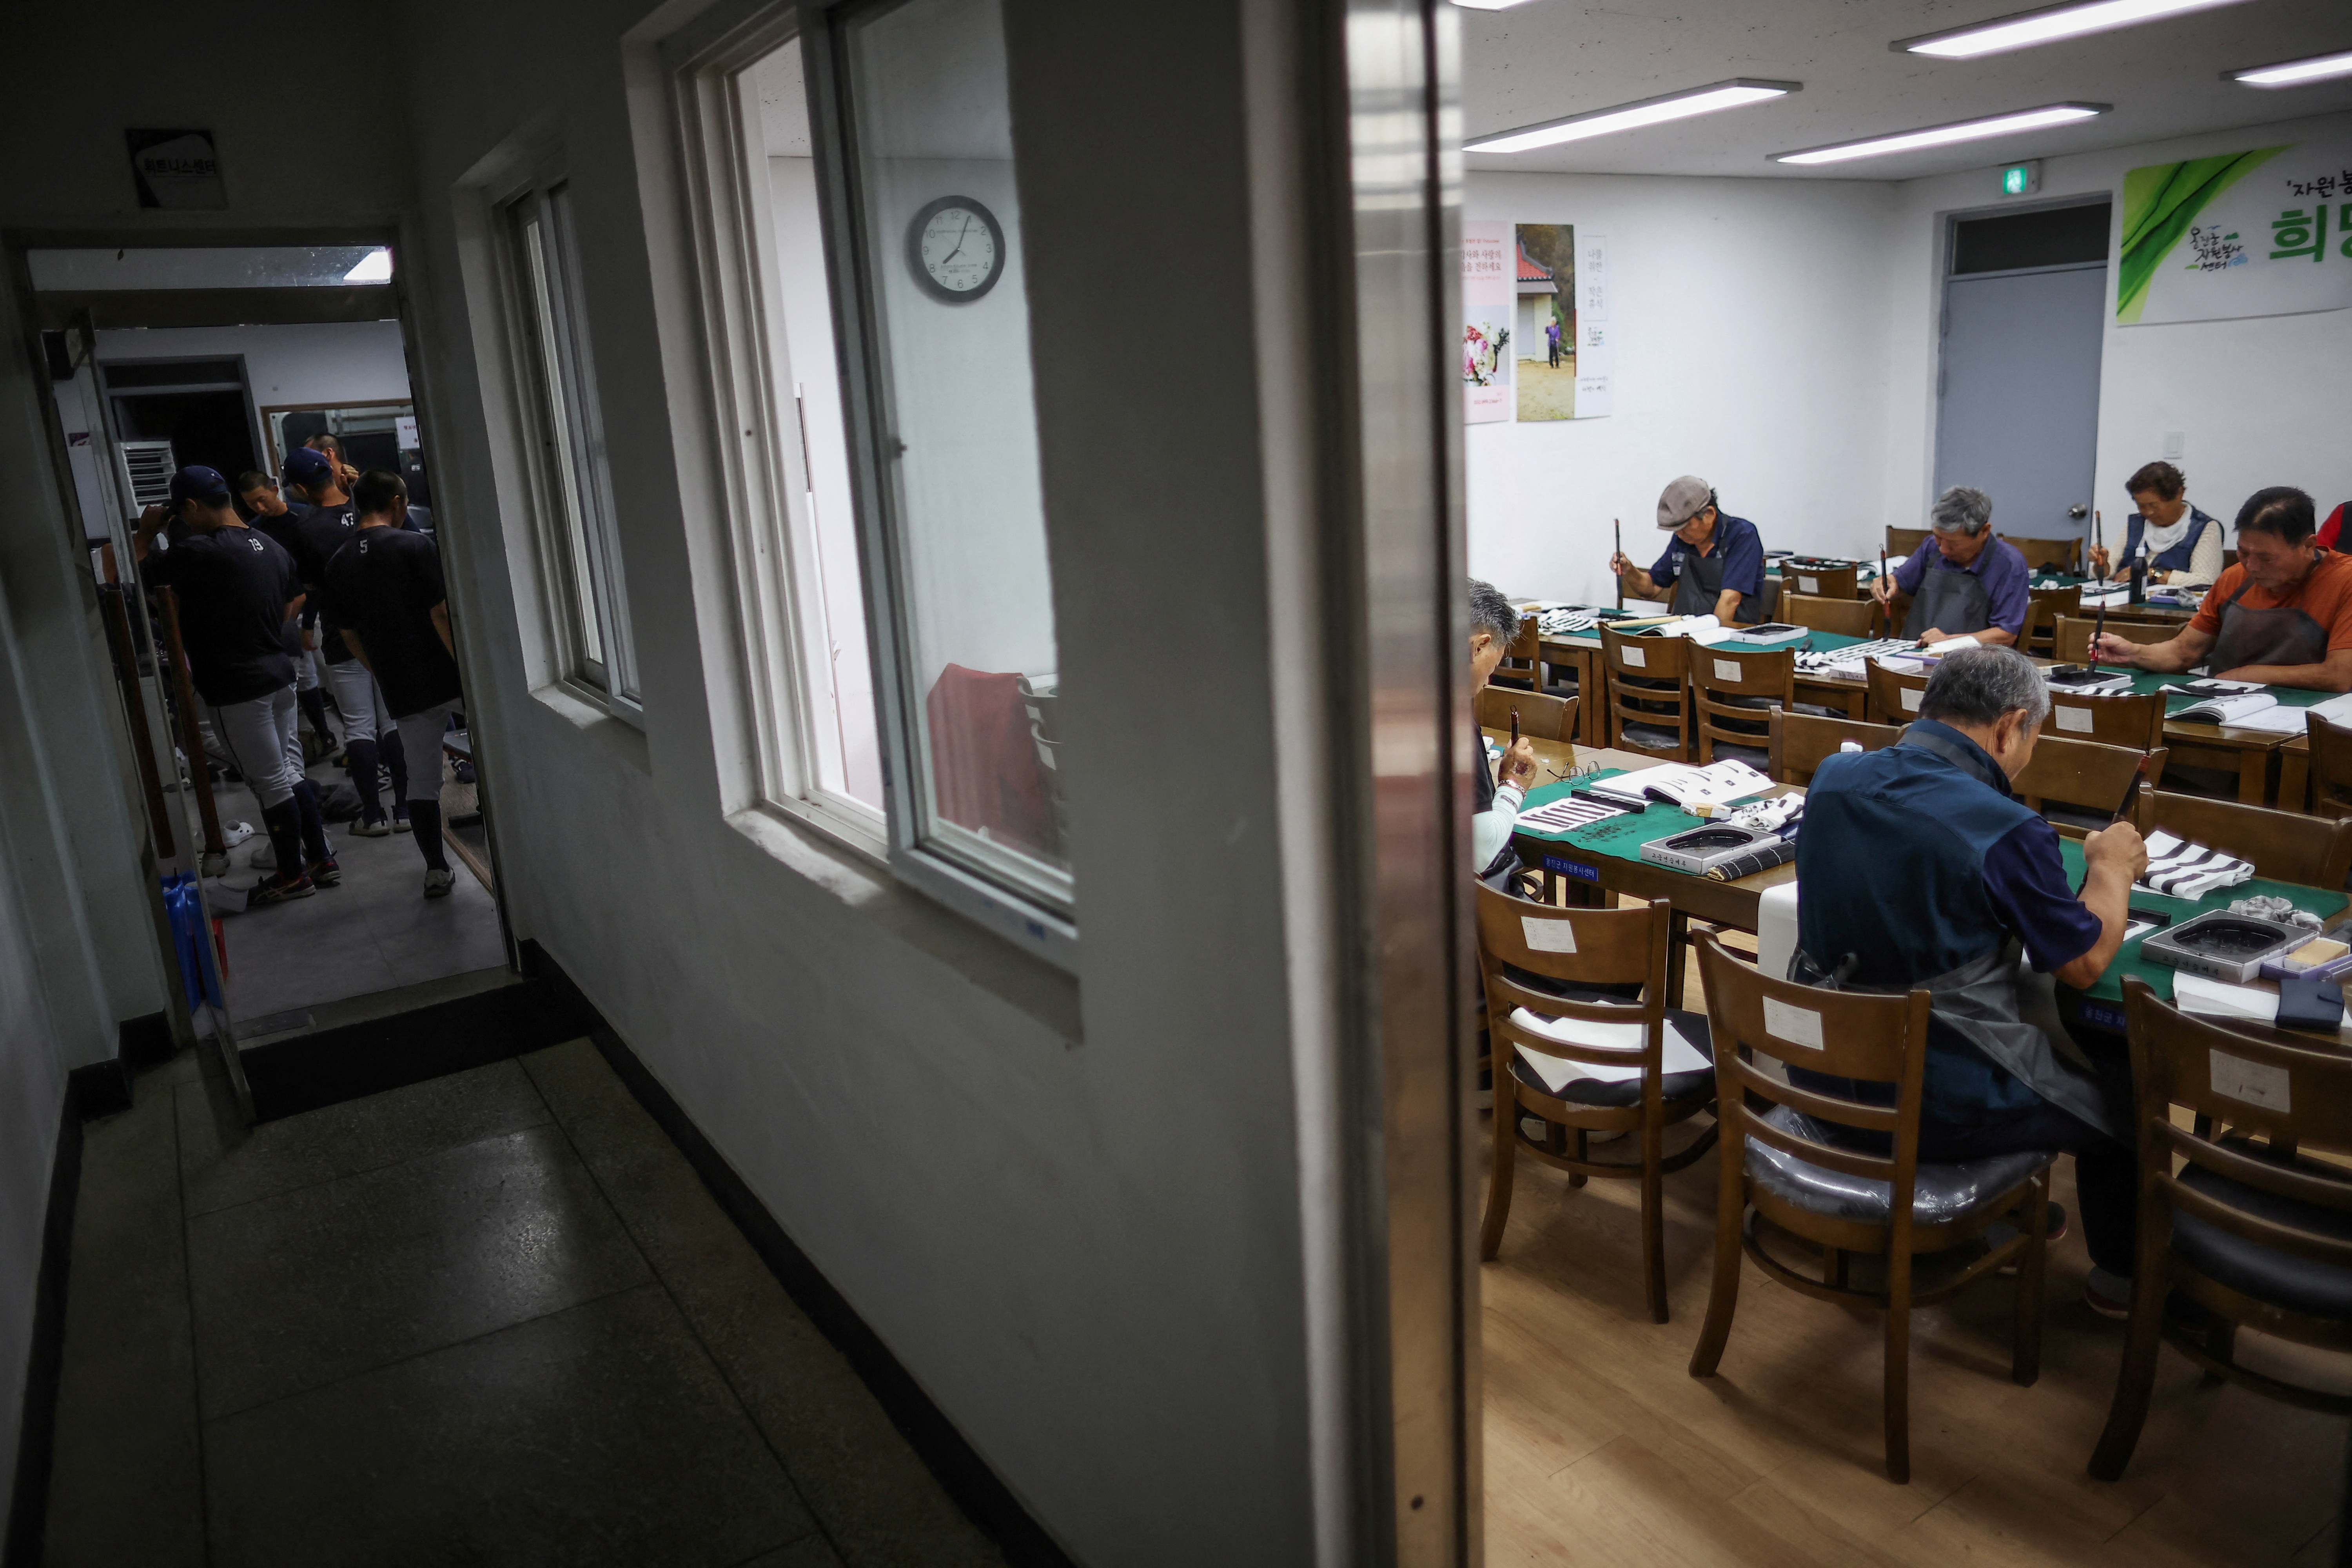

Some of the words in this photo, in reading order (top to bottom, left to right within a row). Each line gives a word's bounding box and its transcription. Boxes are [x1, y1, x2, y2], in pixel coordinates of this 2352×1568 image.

[951, 211, 960, 220] 12
[980, 226, 986, 236] 2
[2269, 203, 2352, 262] 희
[923, 246, 929, 255] 9
[986, 244, 991, 253] 3
[2194, 243, 2244, 262] 자원봉사
[929, 264, 935, 273] 8
[983, 261, 988, 270] 4
[2200, 261, 2227, 272] 센터
[942, 276, 948, 285] 7
[972, 274, 978, 283] 5
[958, 279, 963, 289] 6
[340, 512, 354, 527] 47
[247, 537, 265, 552] 19
[359, 539, 368, 554] 5
